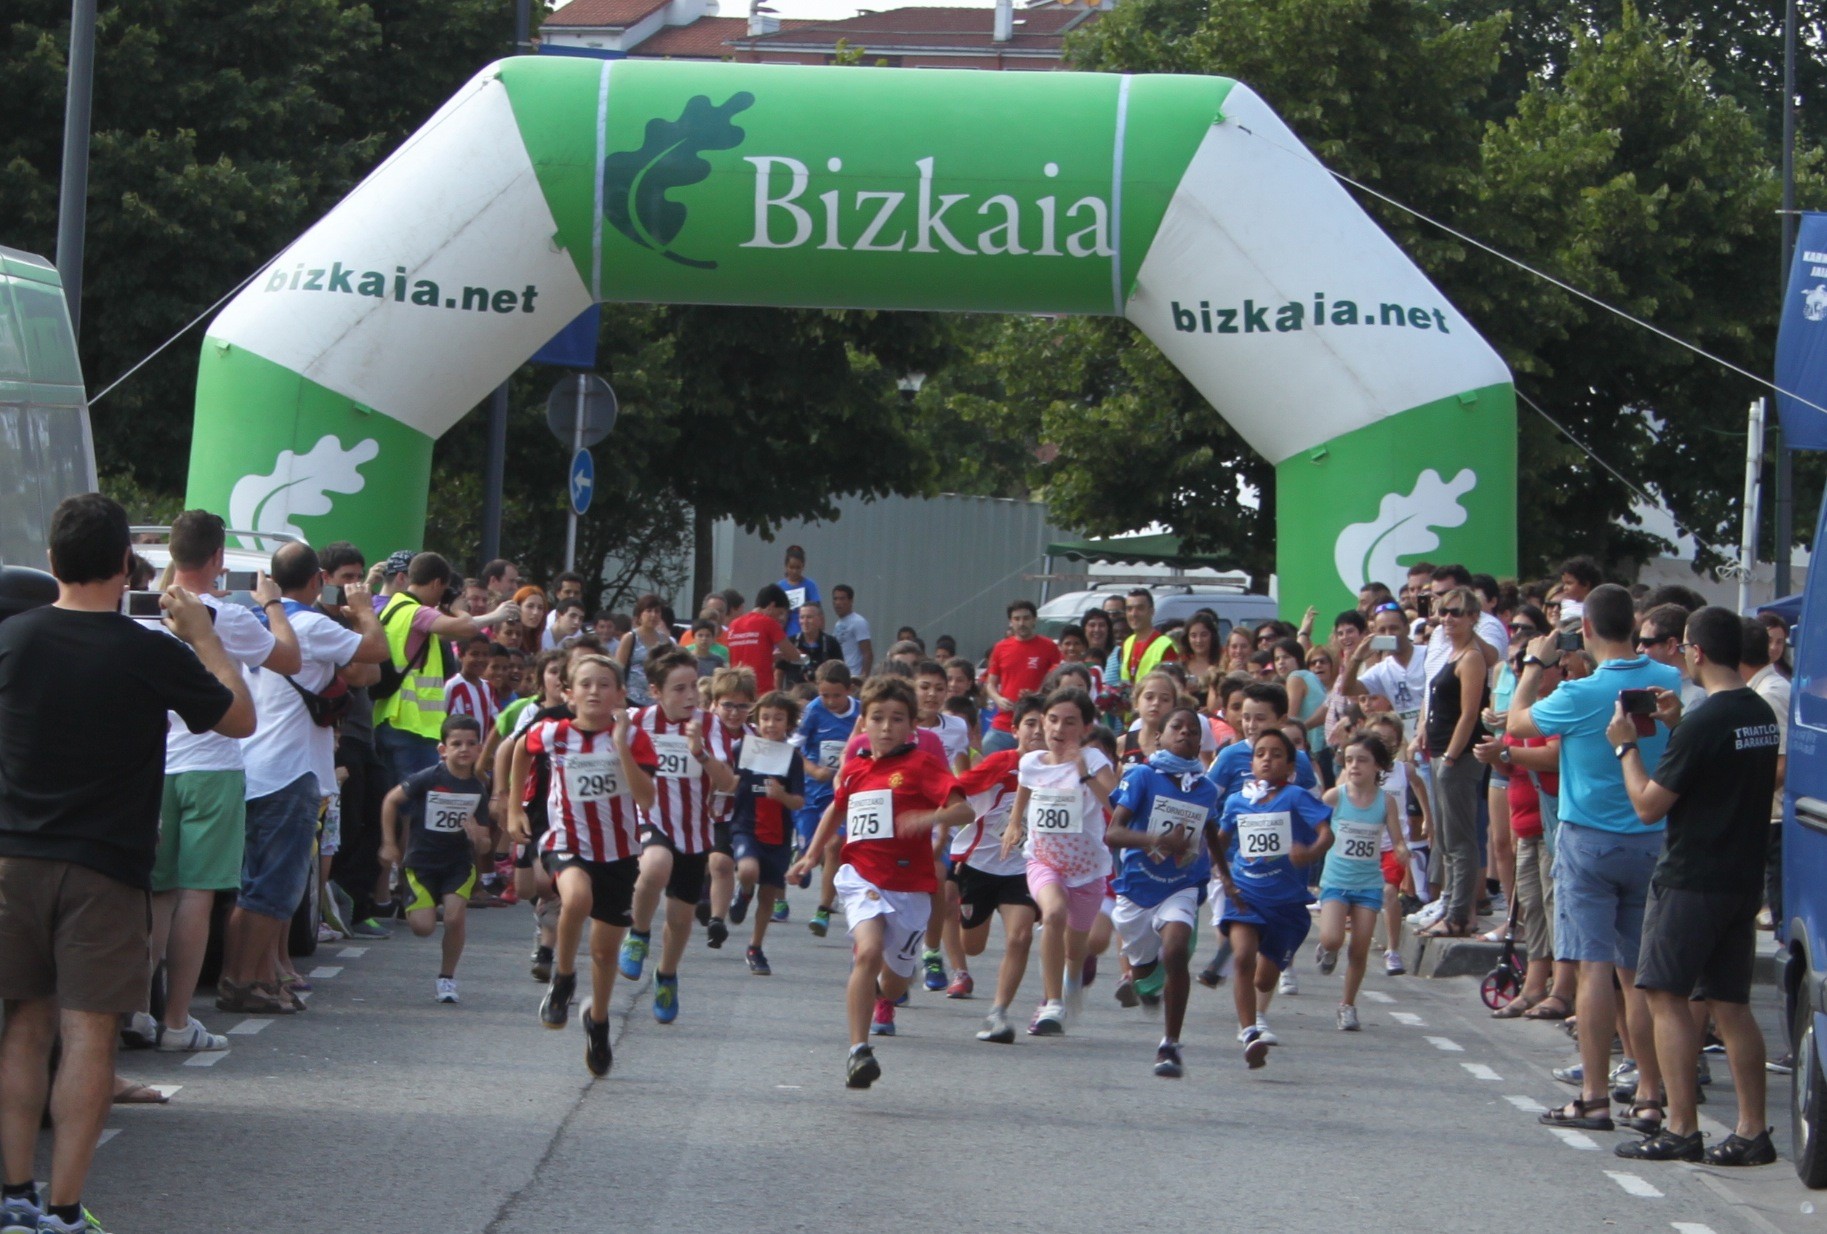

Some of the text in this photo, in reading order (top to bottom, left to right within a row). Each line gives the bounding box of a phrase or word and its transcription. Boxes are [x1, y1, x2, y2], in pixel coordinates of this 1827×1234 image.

[739, 156, 1117, 258] Bizkaia
[264, 261, 539, 314] bizkaia.net
[1171, 292, 1450, 334] bizkaia.net
[657, 754, 688, 773] 291
[577, 773, 617, 797] 295
[435, 810, 468, 829] 266
[852, 813, 879, 836] 275
[1037, 808, 1069, 829] 280
[1160, 820, 1196, 841] 27
[1247, 832, 1281, 853] 298
[1345, 839, 1375, 858] 285
